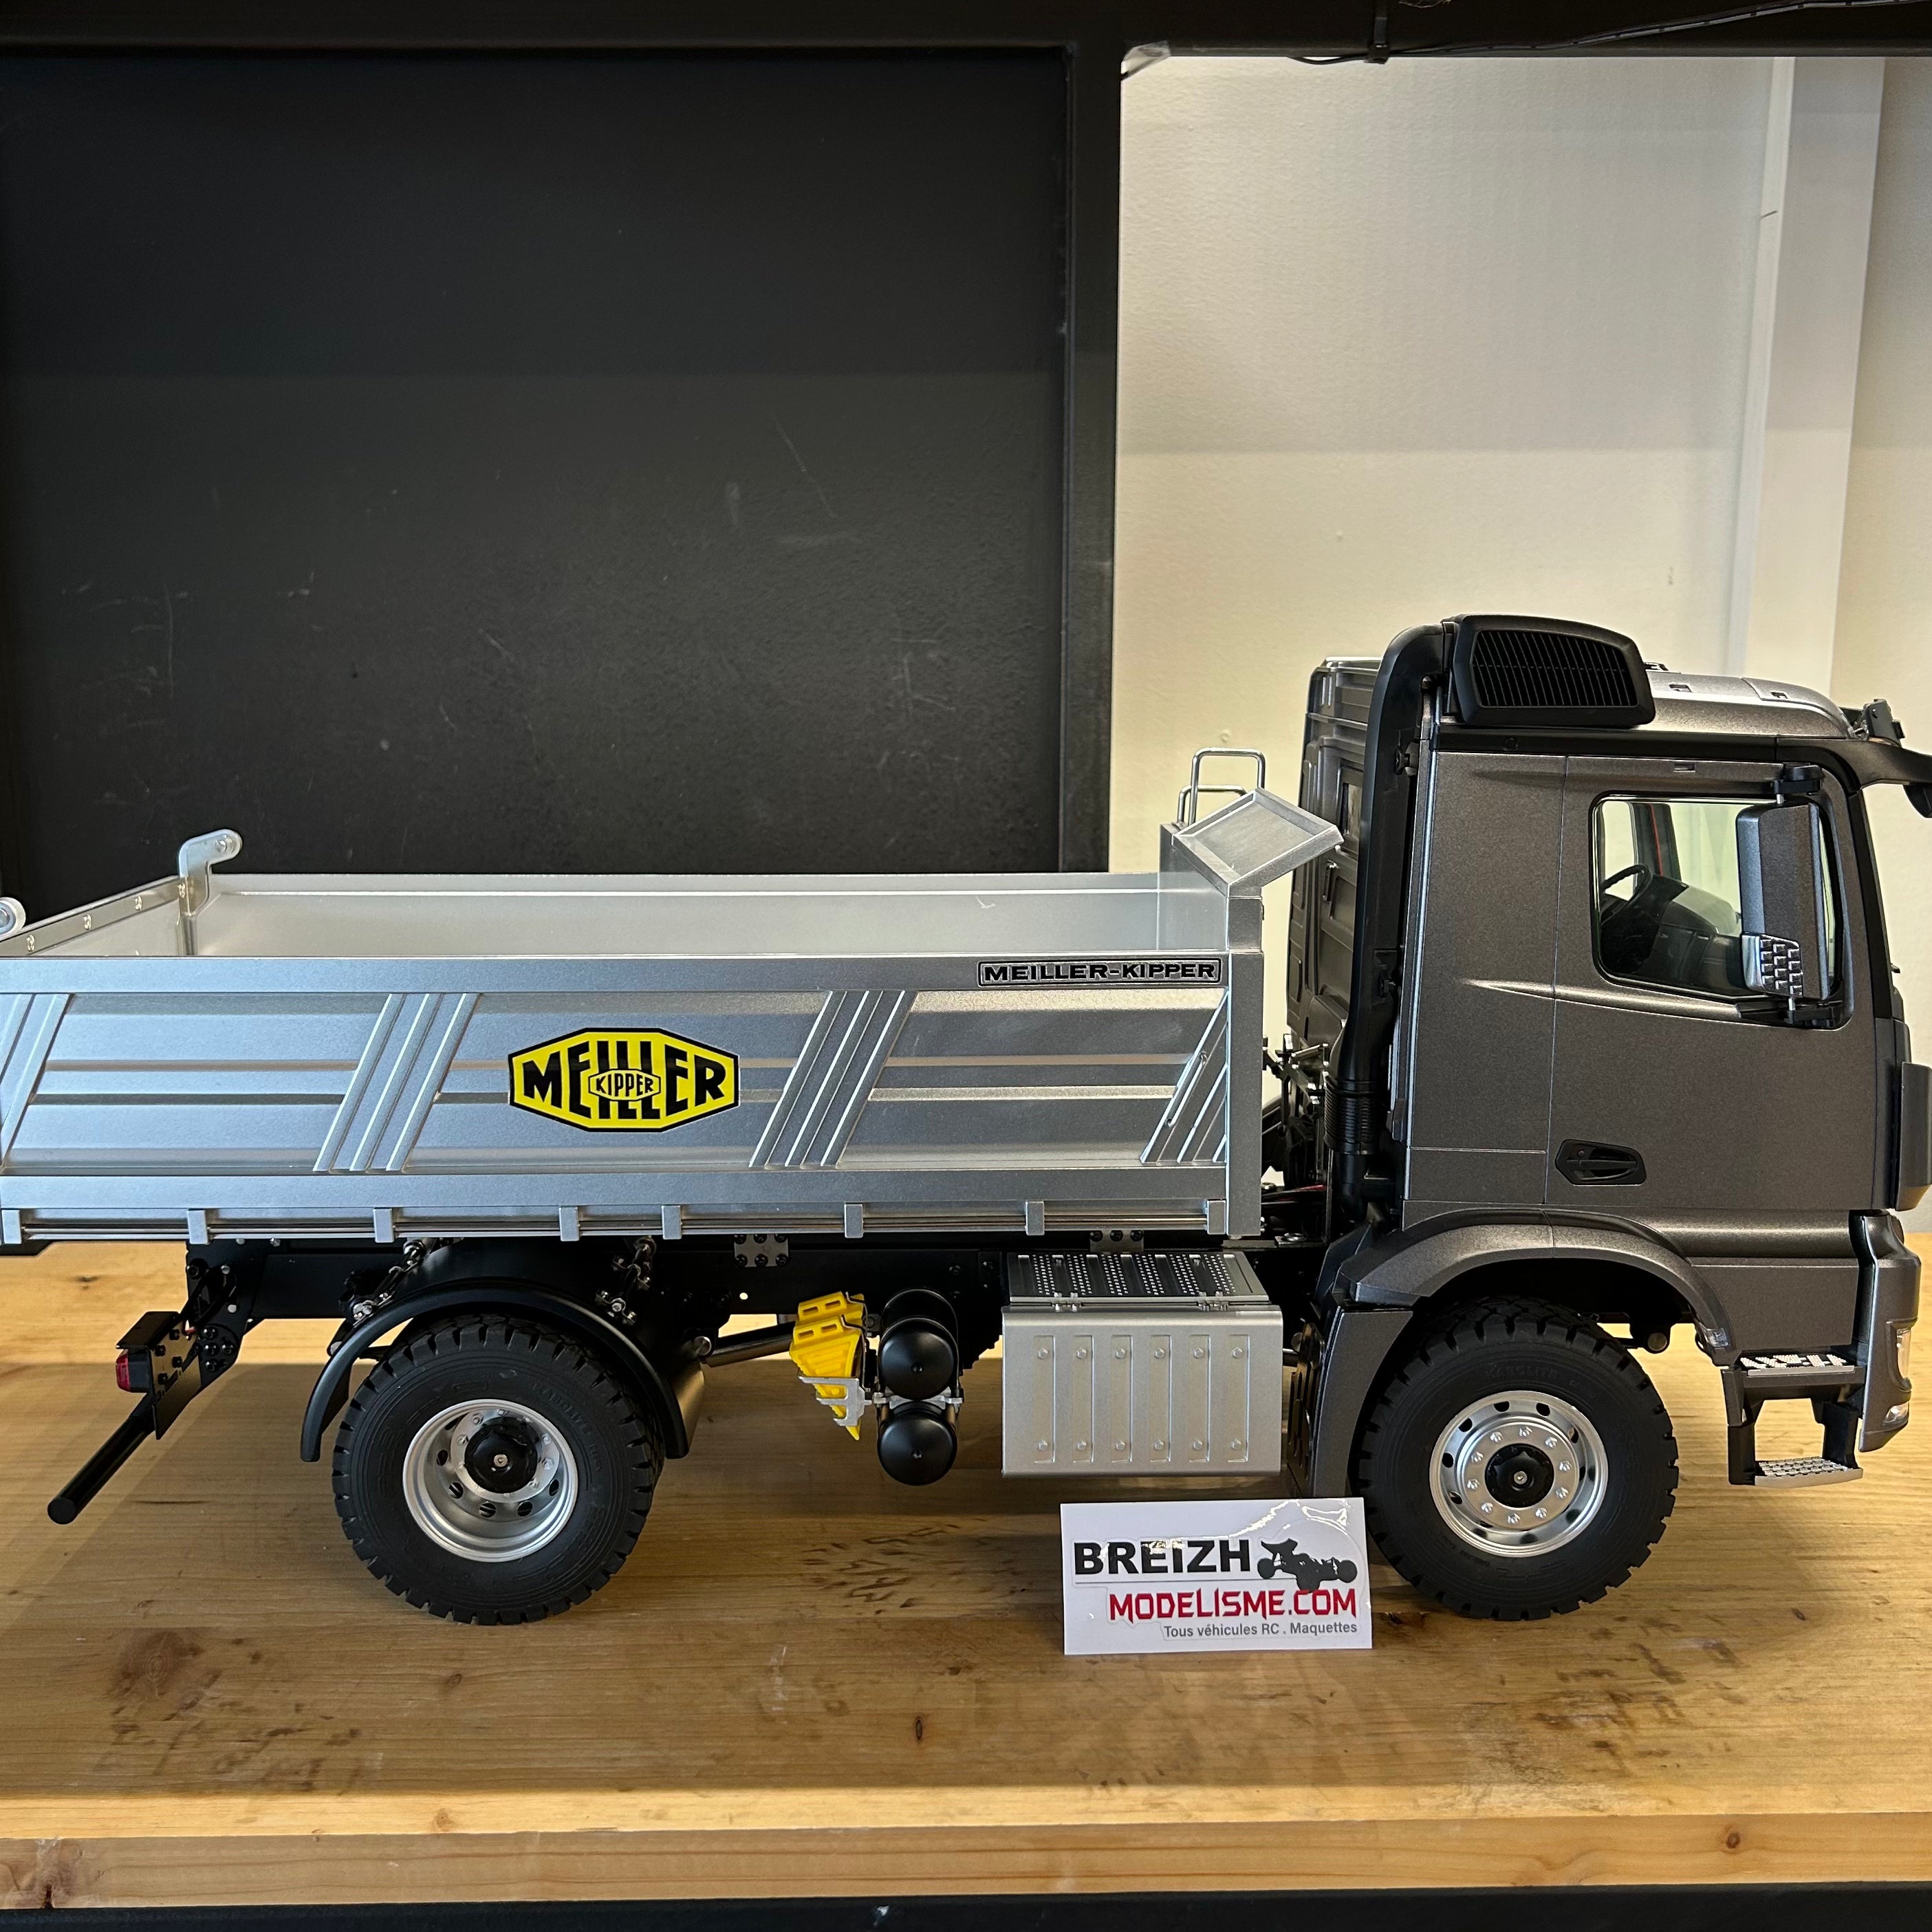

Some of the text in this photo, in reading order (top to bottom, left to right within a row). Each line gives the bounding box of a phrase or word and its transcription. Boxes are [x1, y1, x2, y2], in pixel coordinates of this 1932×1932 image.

[984, 963, 1215, 981] MEILLER-KIPPER
[522, 1040, 726, 1120] MEILLER
[596, 1073, 654, 1097] KIPPER
[1074, 1539, 1251, 1575] BREIZH
[1109, 1587, 1356, 1624] MODELISME.COM
[1164, 1625, 1194, 1637] Tous
[1198, 1622, 1258, 1636] véhicules
[1261, 1623, 1280, 1635] RC
[1290, 1622, 1358, 1636] Maquettes
